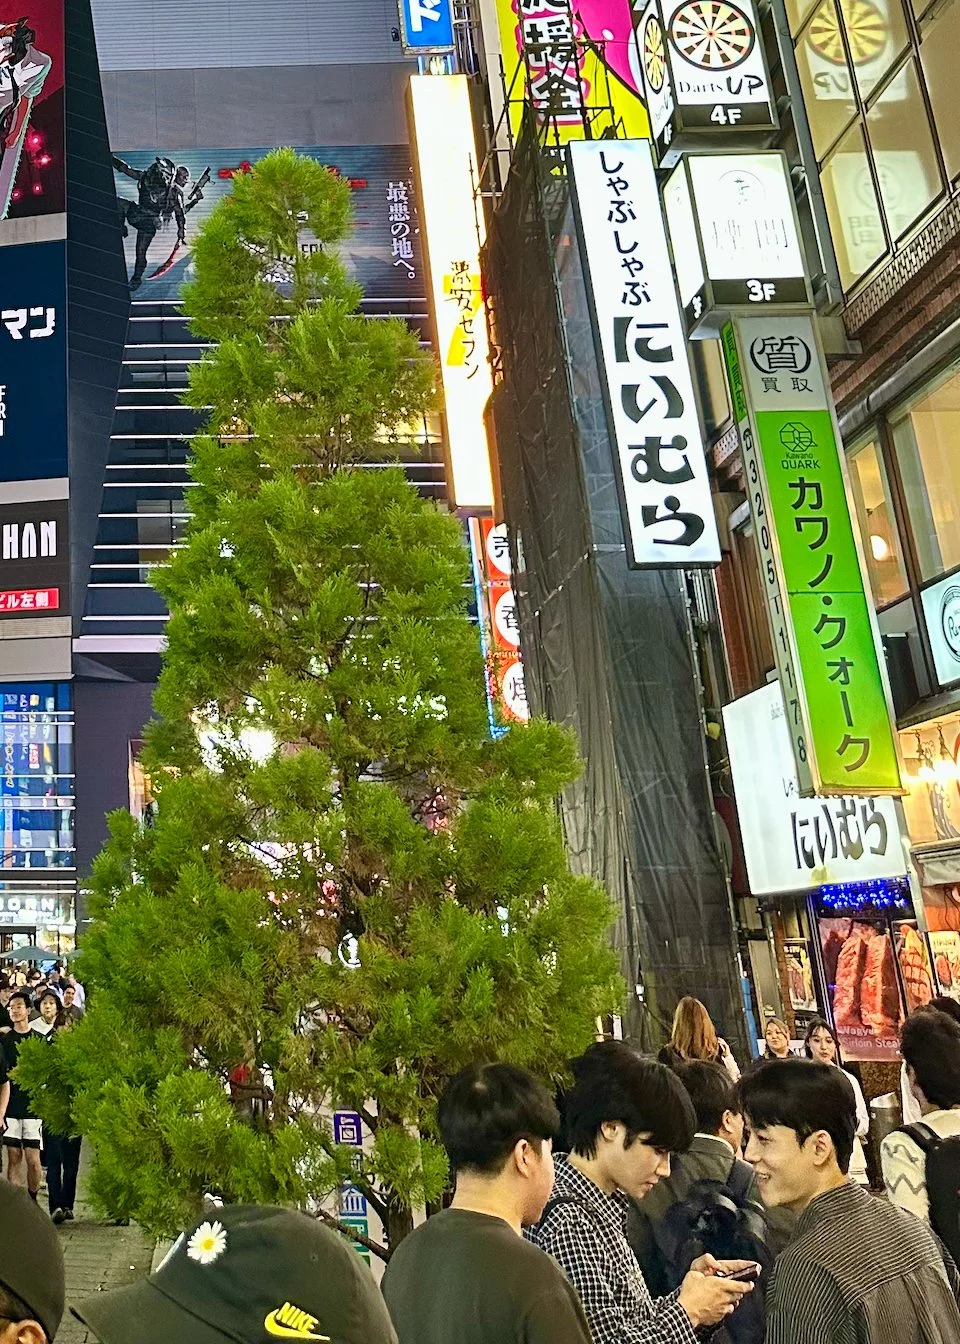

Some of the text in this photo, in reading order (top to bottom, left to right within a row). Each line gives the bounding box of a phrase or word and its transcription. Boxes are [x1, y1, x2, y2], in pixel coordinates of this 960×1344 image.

[679, 74, 764, 95] Darts UP
[710, 105, 742, 125] 4F
[386, 181, 417, 280] 最悪の地へ。
[746, 279, 776, 303] 3F
[598, 150, 705, 548] しゃぶしゃぶ にいむら
[761, 377, 814, 393] 買取
[781, 459, 821, 470] QUARK
[790, 797, 888, 870] にいむら
[276, 1301, 319, 1332] NIKE
